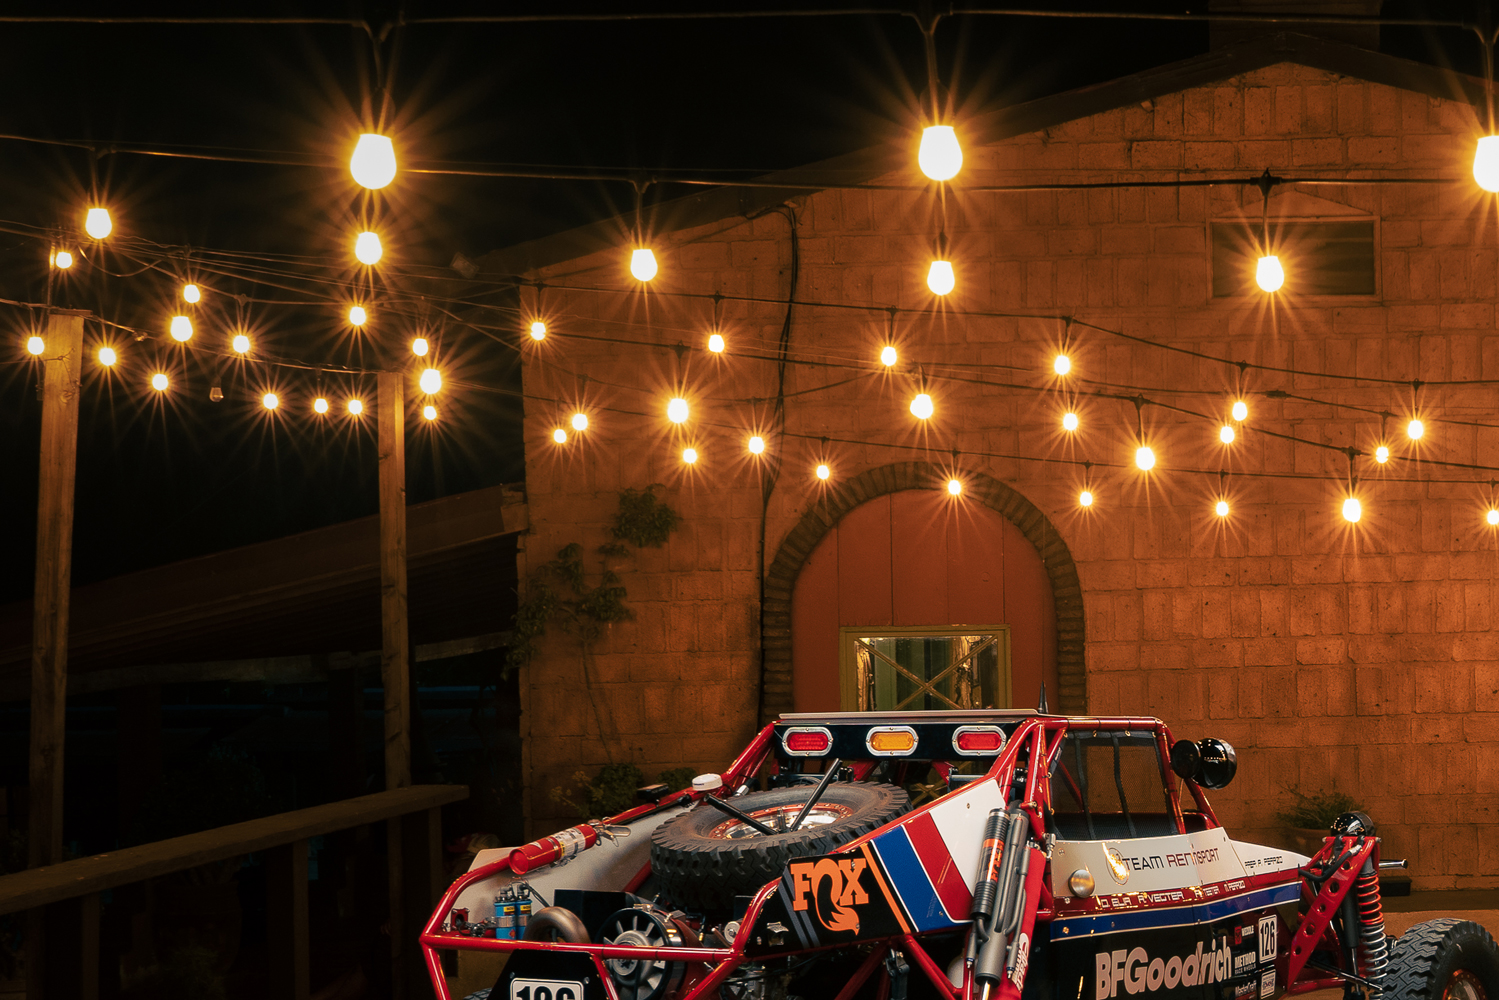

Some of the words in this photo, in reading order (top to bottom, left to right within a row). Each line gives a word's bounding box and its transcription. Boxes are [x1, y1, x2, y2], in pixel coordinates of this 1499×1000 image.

[1122, 855, 1164, 871] TEAM
[1166, 848, 1219, 868] RENNSPORT
[790, 858, 869, 936] FOX
[1261, 920, 1275, 957] 126
[1095, 935, 1232, 1000] BFGoodrich
[1235, 951, 1256, 969] METHOD
